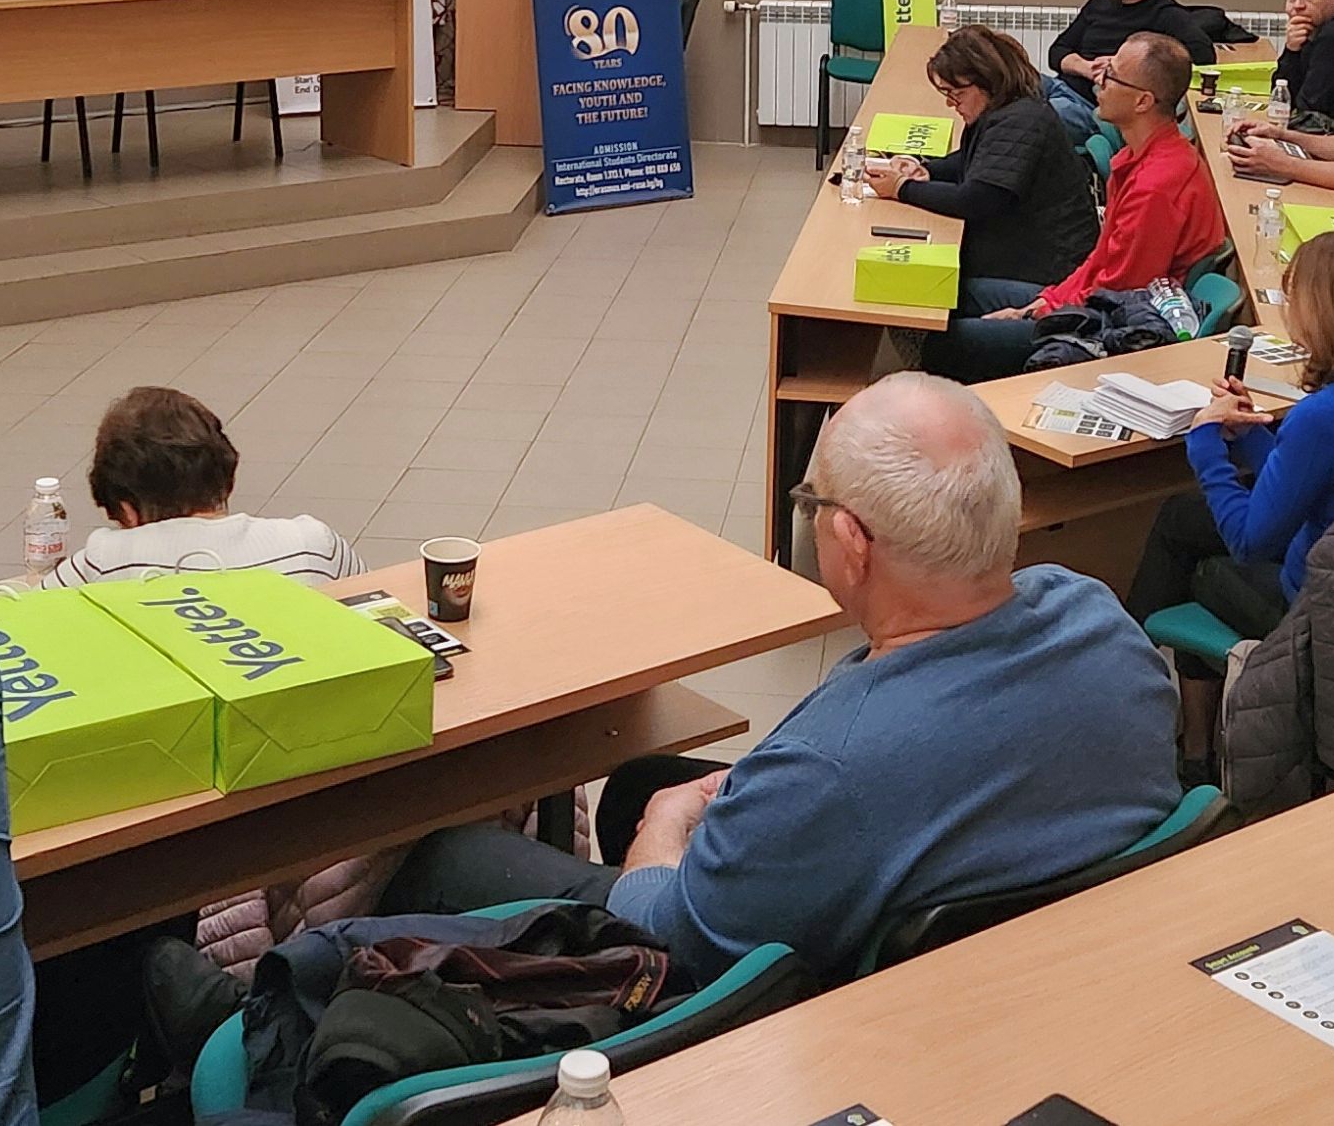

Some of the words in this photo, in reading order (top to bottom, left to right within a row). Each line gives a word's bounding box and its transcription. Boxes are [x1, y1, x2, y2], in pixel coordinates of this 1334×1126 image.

[564, 4, 641, 61] 80
[592, 57, 623, 70] YEARS
[294, 86, 310, 95] End
[552, 80, 592, 97] FACING
[593, 74, 667, 94] KNOWLEDGE,
[578, 93, 617, 109] YOUTH
[618, 91, 643, 105] AND
[575, 112, 599, 125] THE
[600, 106, 649, 123] FUTURE!
[593, 141, 638, 155] ADMISSION
[556, 157, 602, 173] International
[603, 154, 636, 168] Students
[636, 150, 678, 164] Directorate
[136, 587, 306, 681] Yettel.
